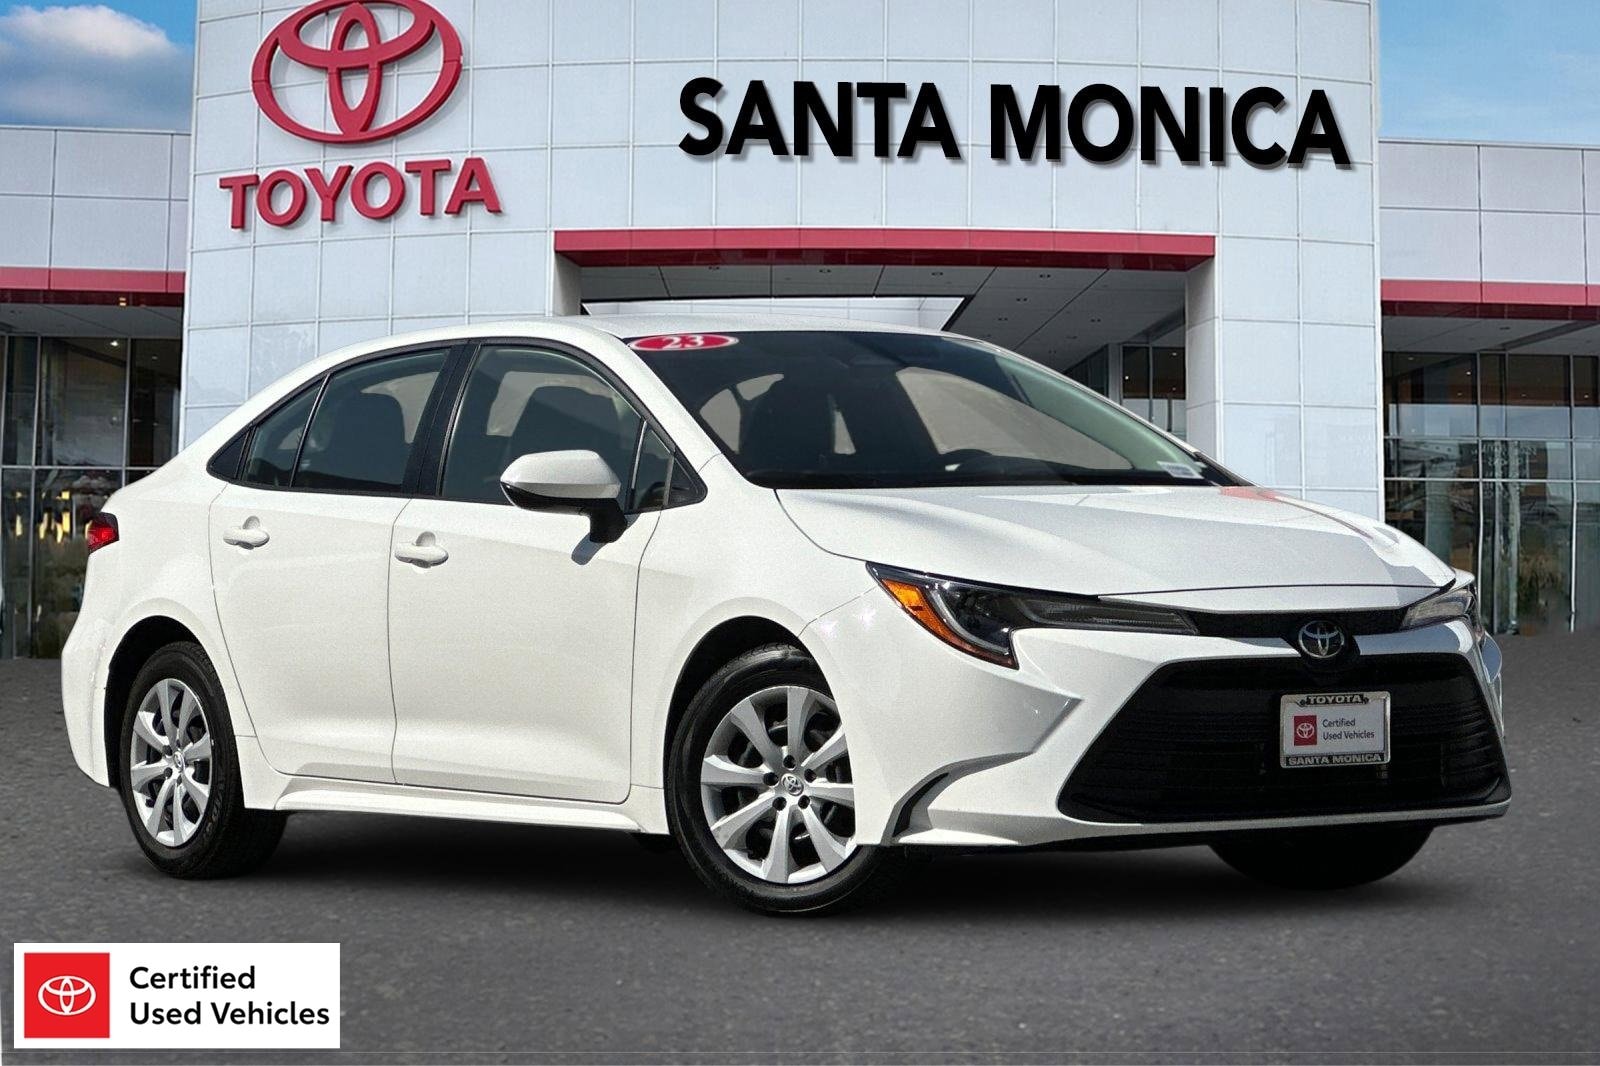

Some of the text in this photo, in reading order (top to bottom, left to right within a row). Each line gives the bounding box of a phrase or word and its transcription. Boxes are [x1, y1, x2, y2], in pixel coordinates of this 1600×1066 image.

[679, 77, 1352, 168] SANTA MONICA
[220, 157, 501, 229] TOYOTA
[662, 336, 704, 348] 23
[1308, 694, 1362, 704] TOYOTA
[1322, 718, 1355, 727] Certified
[1323, 730, 1375, 740] Used Vehicles
[1289, 754, 1381, 765] SANTA MONICA
